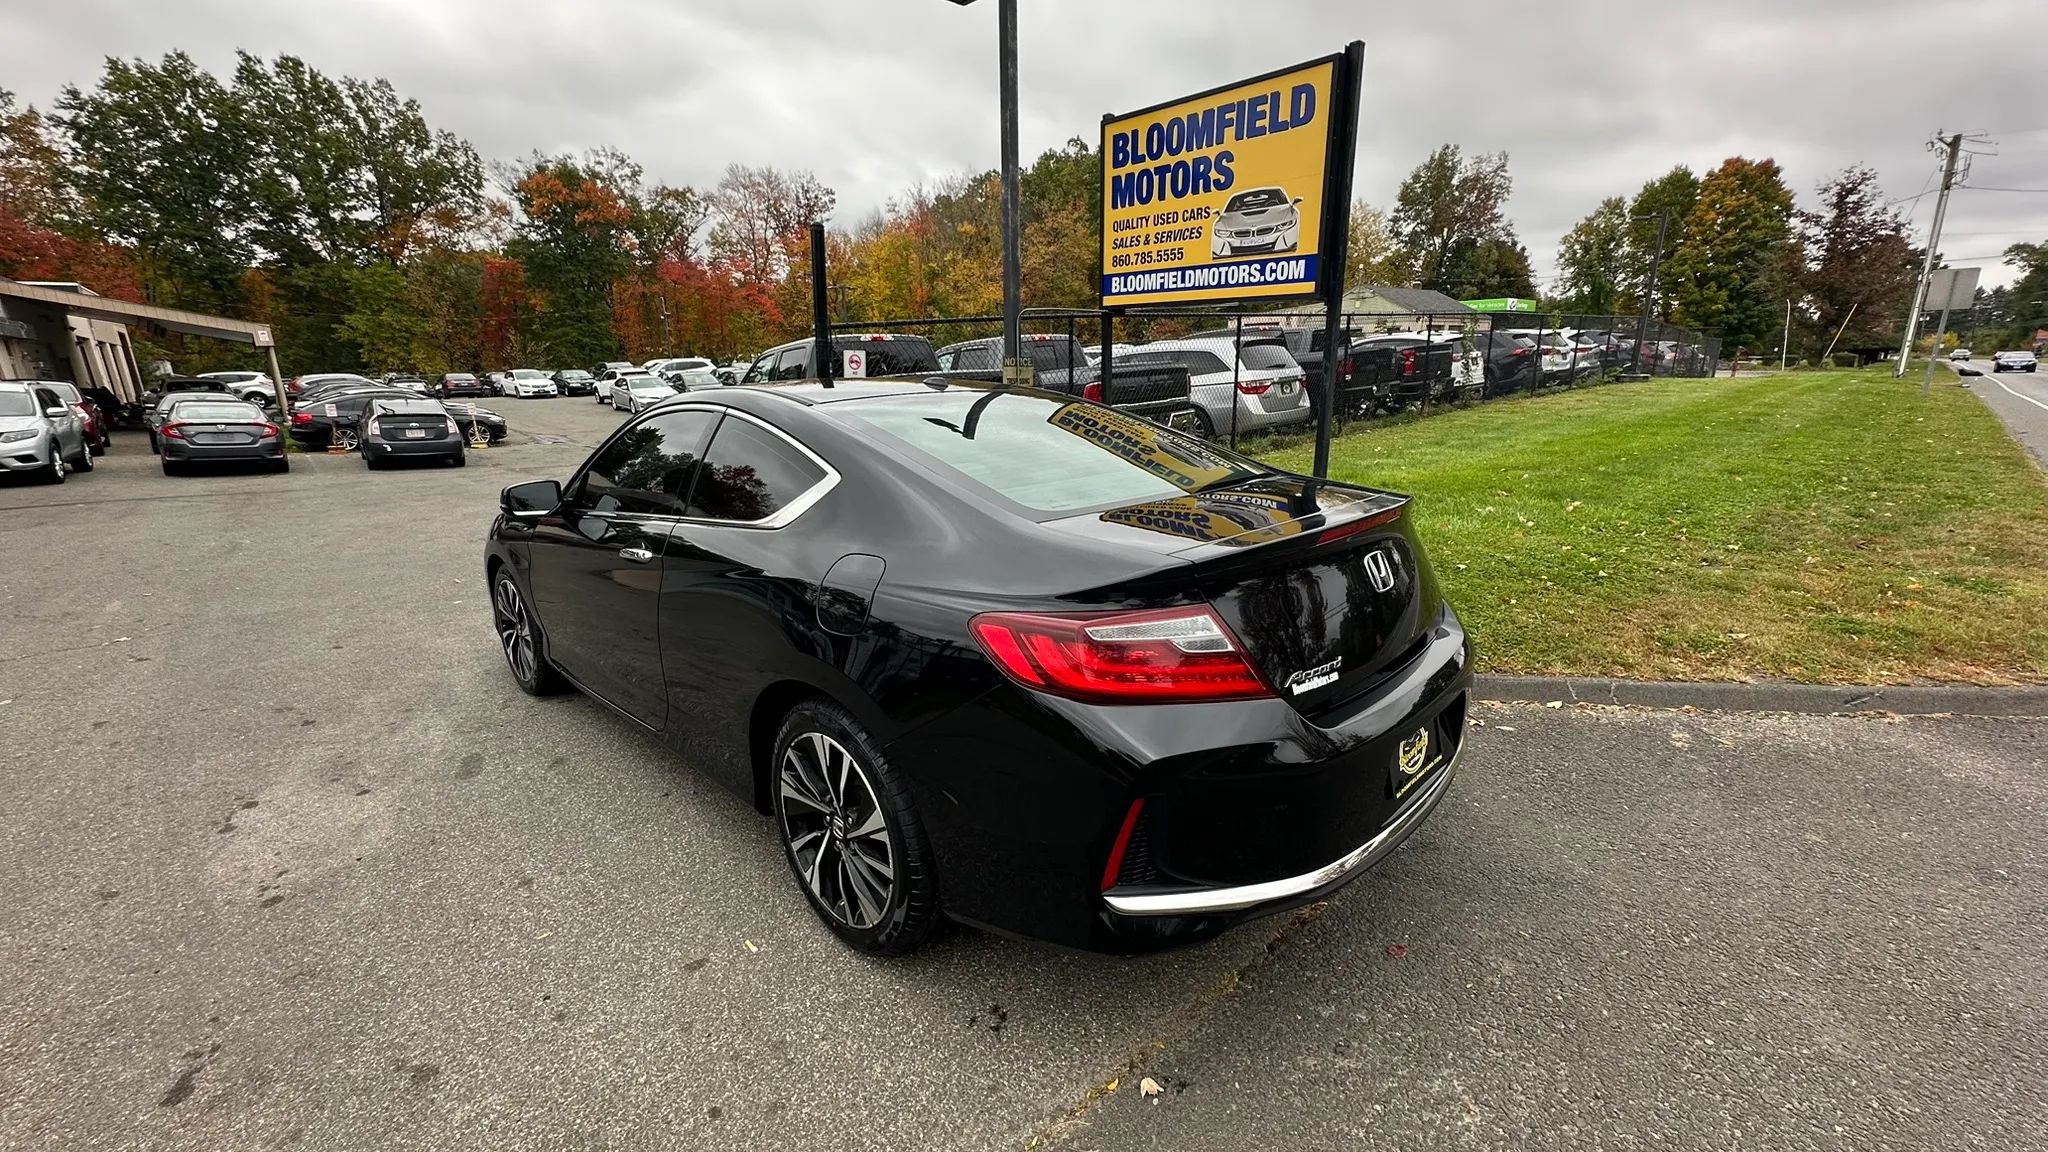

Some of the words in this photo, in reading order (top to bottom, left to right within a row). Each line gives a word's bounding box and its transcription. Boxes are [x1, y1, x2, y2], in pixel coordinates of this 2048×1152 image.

[1112, 83, 1316, 169] BLOOMFIELD
[1111, 150, 1235, 209] MOTORS
[1112, 215, 1150, 233] QUALITY
[1153, 211, 1178, 227] USED
[1182, 206, 1211, 222] CARS
[1112, 233, 1141, 250] SALES
[1143, 233, 1151, 246] &
[1153, 226, 1203, 245] SERVICES
[1112, 247, 1184, 268] 860.785.5555
[1111, 259, 1306, 294] BLOOMFIELDMOTORS.COM
[1004, 357, 1033, 367] NOICE
[1284, 655, 1342, 688] Accord
